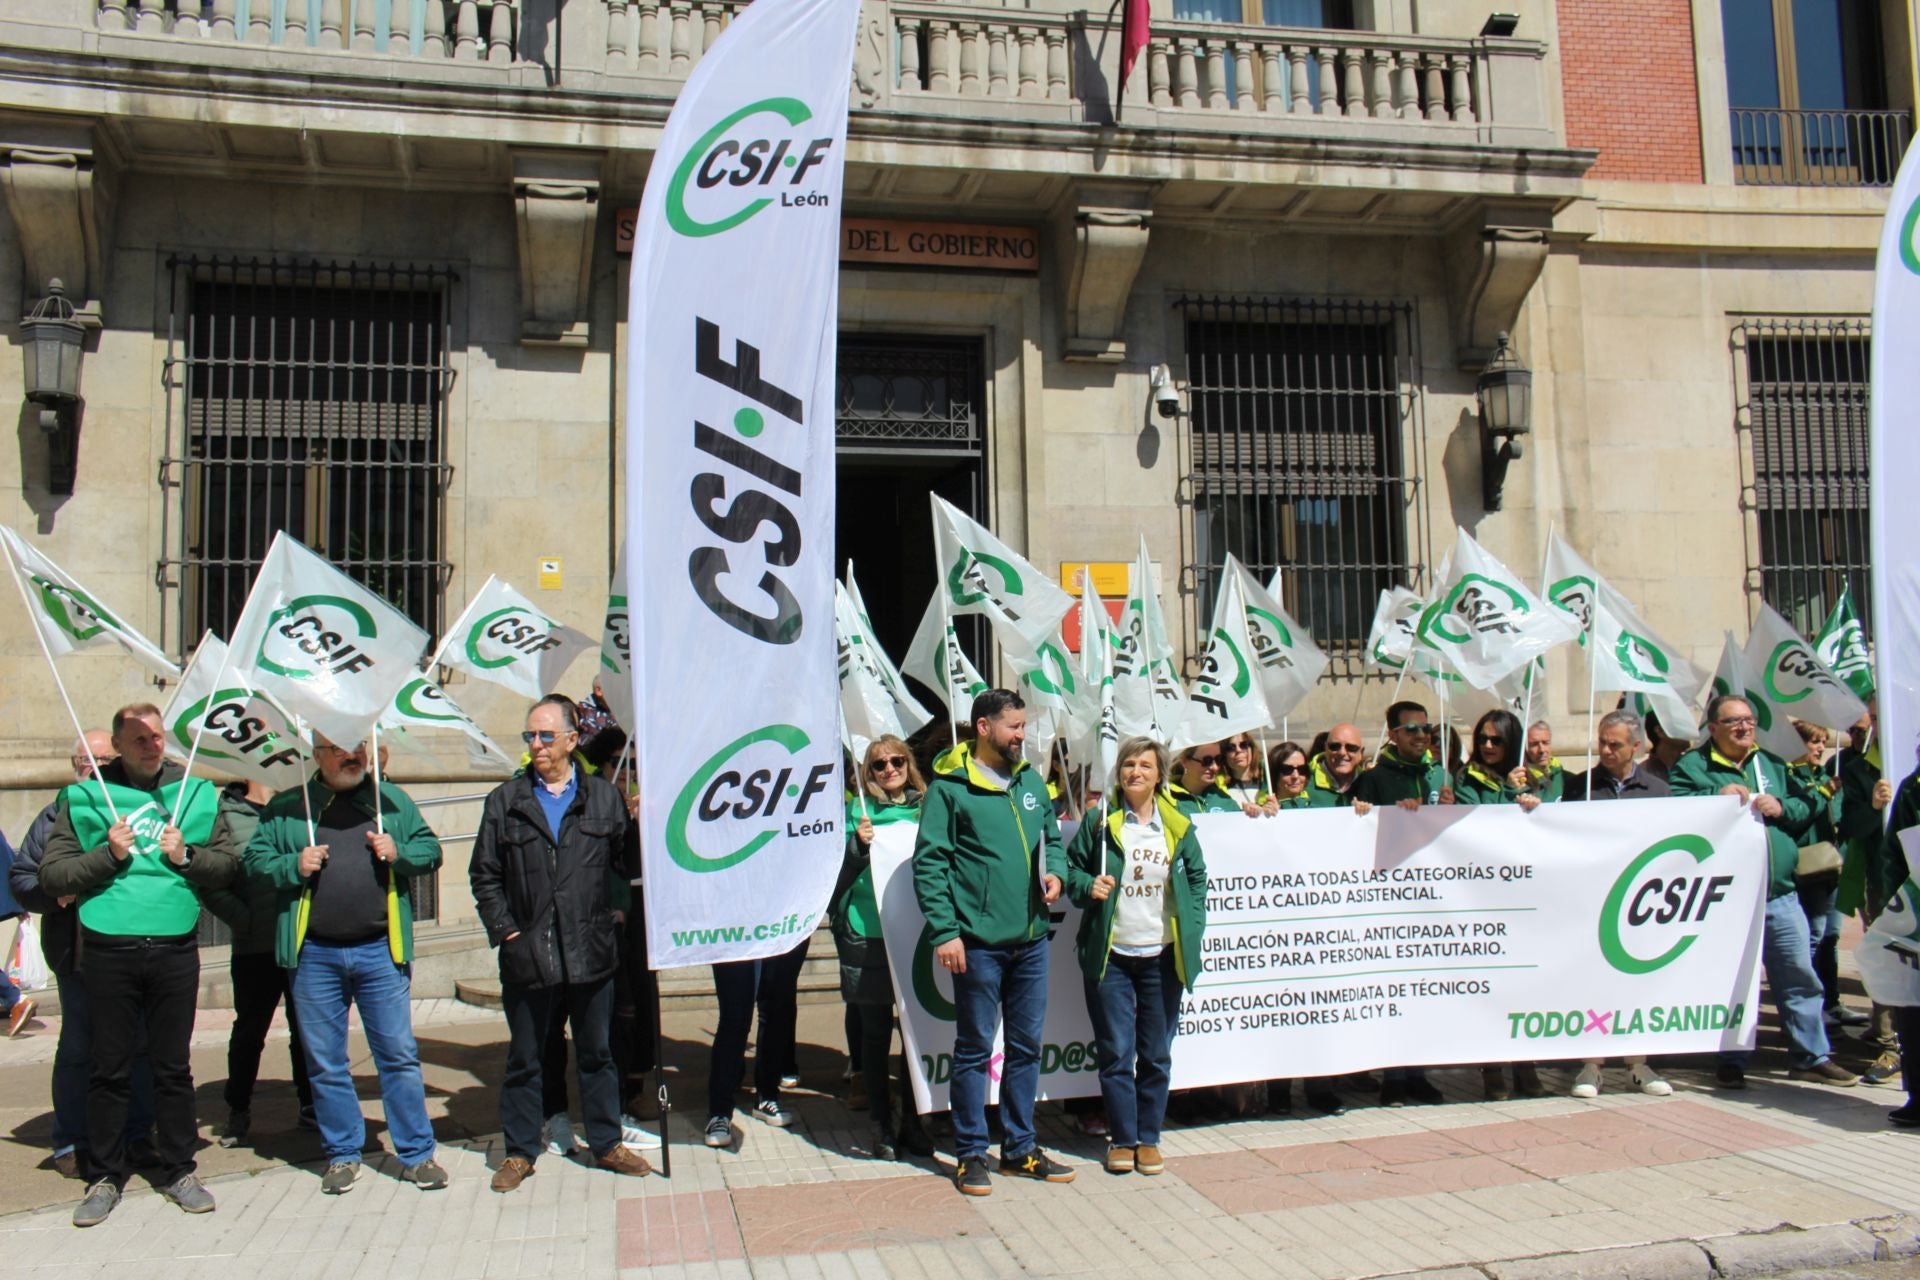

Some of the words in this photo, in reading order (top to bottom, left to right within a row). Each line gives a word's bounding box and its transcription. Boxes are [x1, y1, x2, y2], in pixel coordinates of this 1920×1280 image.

[781, 191, 829, 207] León
[847, 229, 900, 252] DEL
[908, 231, 1036, 259] GOBIERNO
[487, 617, 561, 654] CSIF
[787, 818, 834, 838] León
[1133, 865, 1144, 881] &
[1206, 876, 1257, 892] ATUTO
[1262, 873, 1305, 889] PARA
[1308, 870, 1359, 886] TODAS
[1362, 868, 1388, 884] LAS
[1392, 862, 1494, 882] CATEGORÍAS
[1499, 865, 1533, 882] QUE
[1248, 894, 1270, 909] LA
[1272, 890, 1341, 908] CALIDAD
[1346, 886, 1443, 904] ASISTENCIAL.
[1627, 875, 1735, 927] CSIF
[1200, 930, 1289, 953] UBILACIÓN
[1293, 929, 1360, 946] PARCIAL,
[1363, 924, 1455, 941] ANTICIPADA
[1457, 923, 1468, 937] Y
[1473, 922, 1507, 937] POR
[1270, 951, 1316, 967] PARA
[1319, 946, 1391, 964] PERSONAL
[1396, 941, 1506, 958] ESTATUTARIO.
[1200, 988, 1306, 1013] ADECUACIÓN
[1311, 985, 1384, 1005] INMEDIATA
[1388, 983, 1406, 998] DE
[1410, 978, 1490, 997] TÉCNICOS
[1226, 1017, 1235, 1031] Y
[1240, 1009, 1339, 1029] SUPERIORES
[1343, 1007, 1357, 1022] AL
[1360, 1005, 1373, 1020] C1
[1375, 1004, 1384, 1018] Y
[1389, 1003, 1402, 1017] B.
